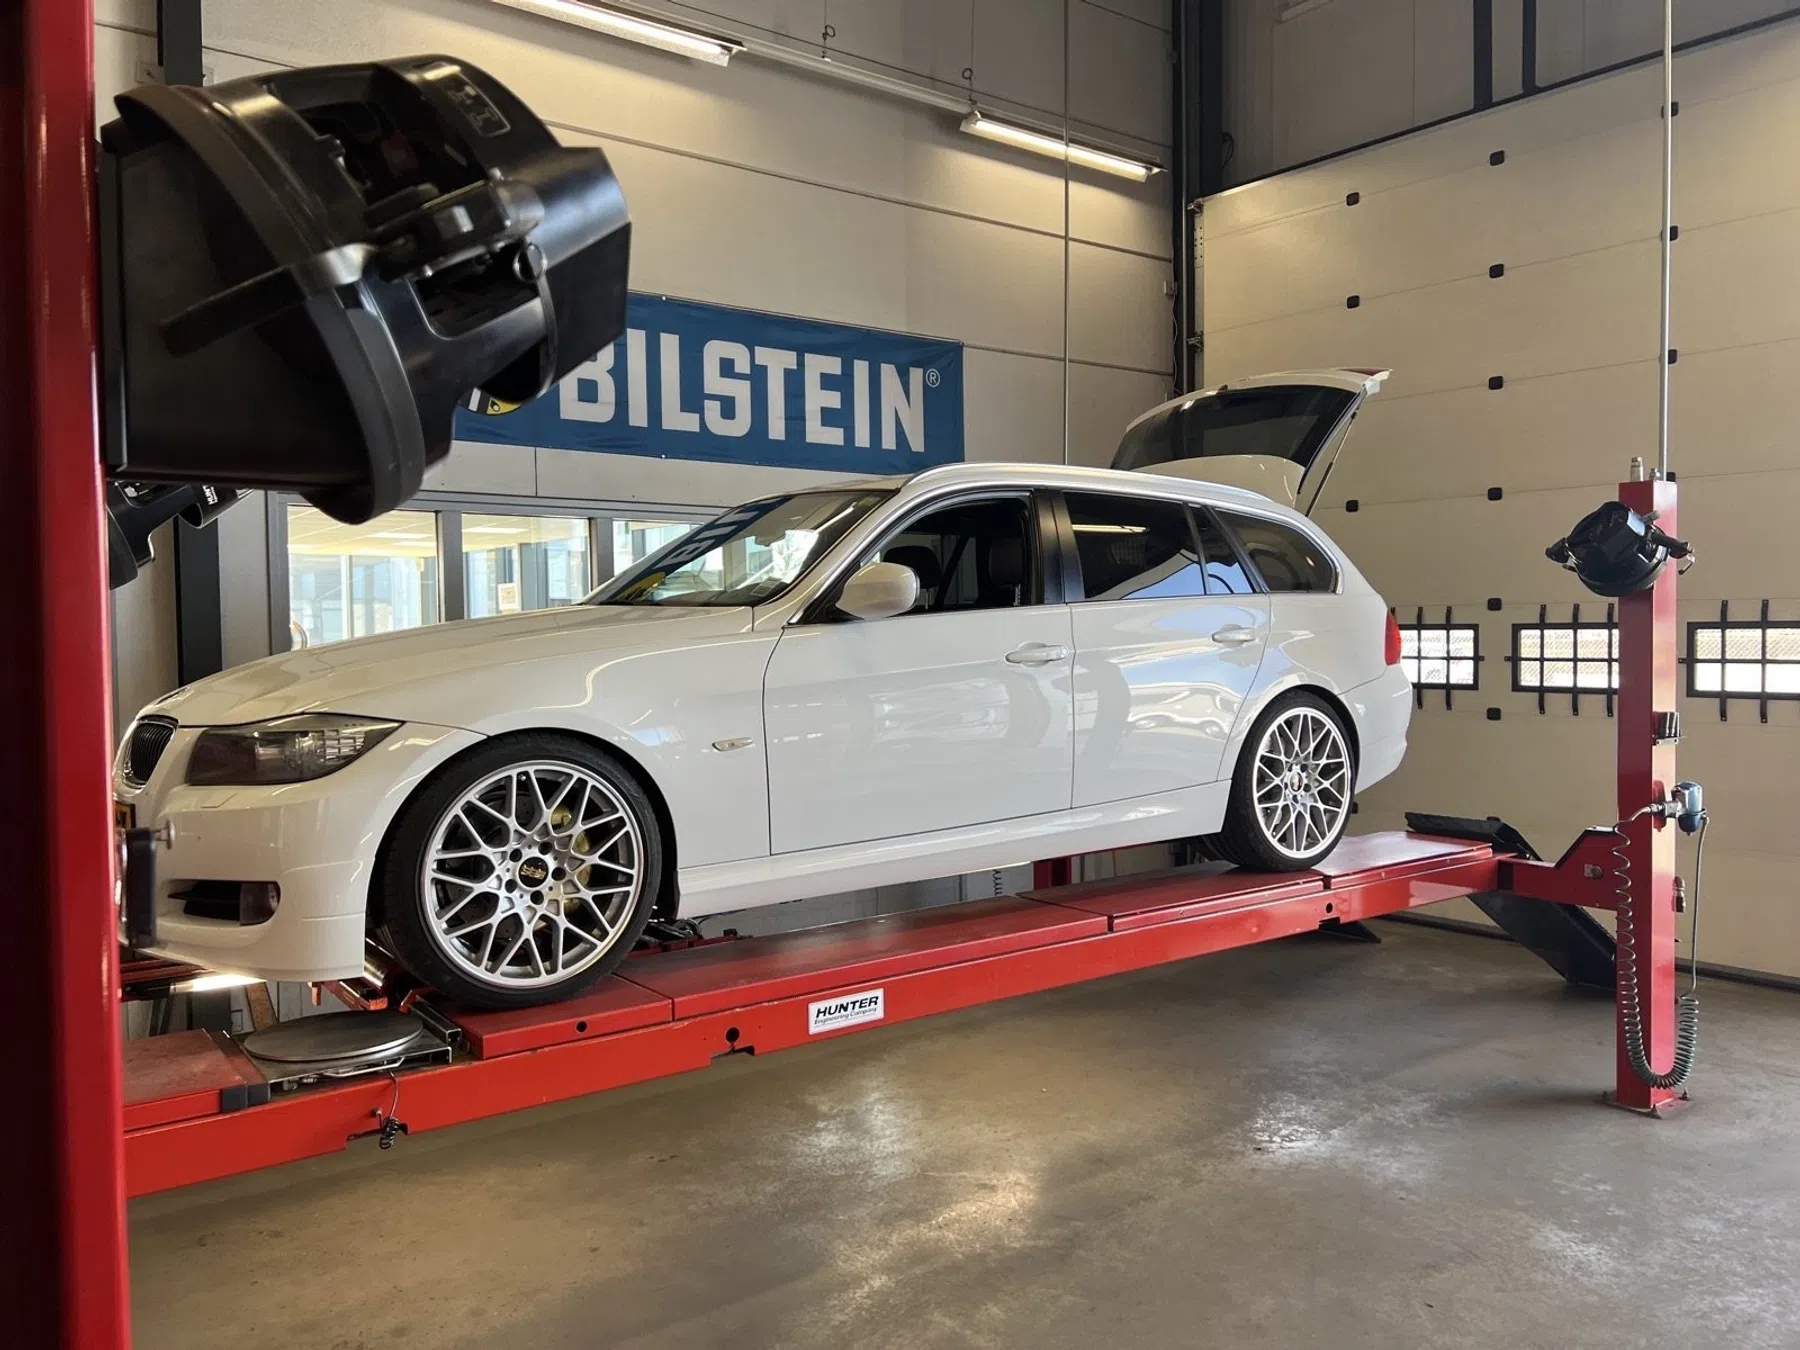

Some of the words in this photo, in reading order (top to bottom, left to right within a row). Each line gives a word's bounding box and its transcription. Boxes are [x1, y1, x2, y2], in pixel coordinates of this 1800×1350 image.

[814, 1012, 850, 1025] Engineering
[850, 1008, 877, 1017] Company
[815, 996, 879, 1018] HUNTER
